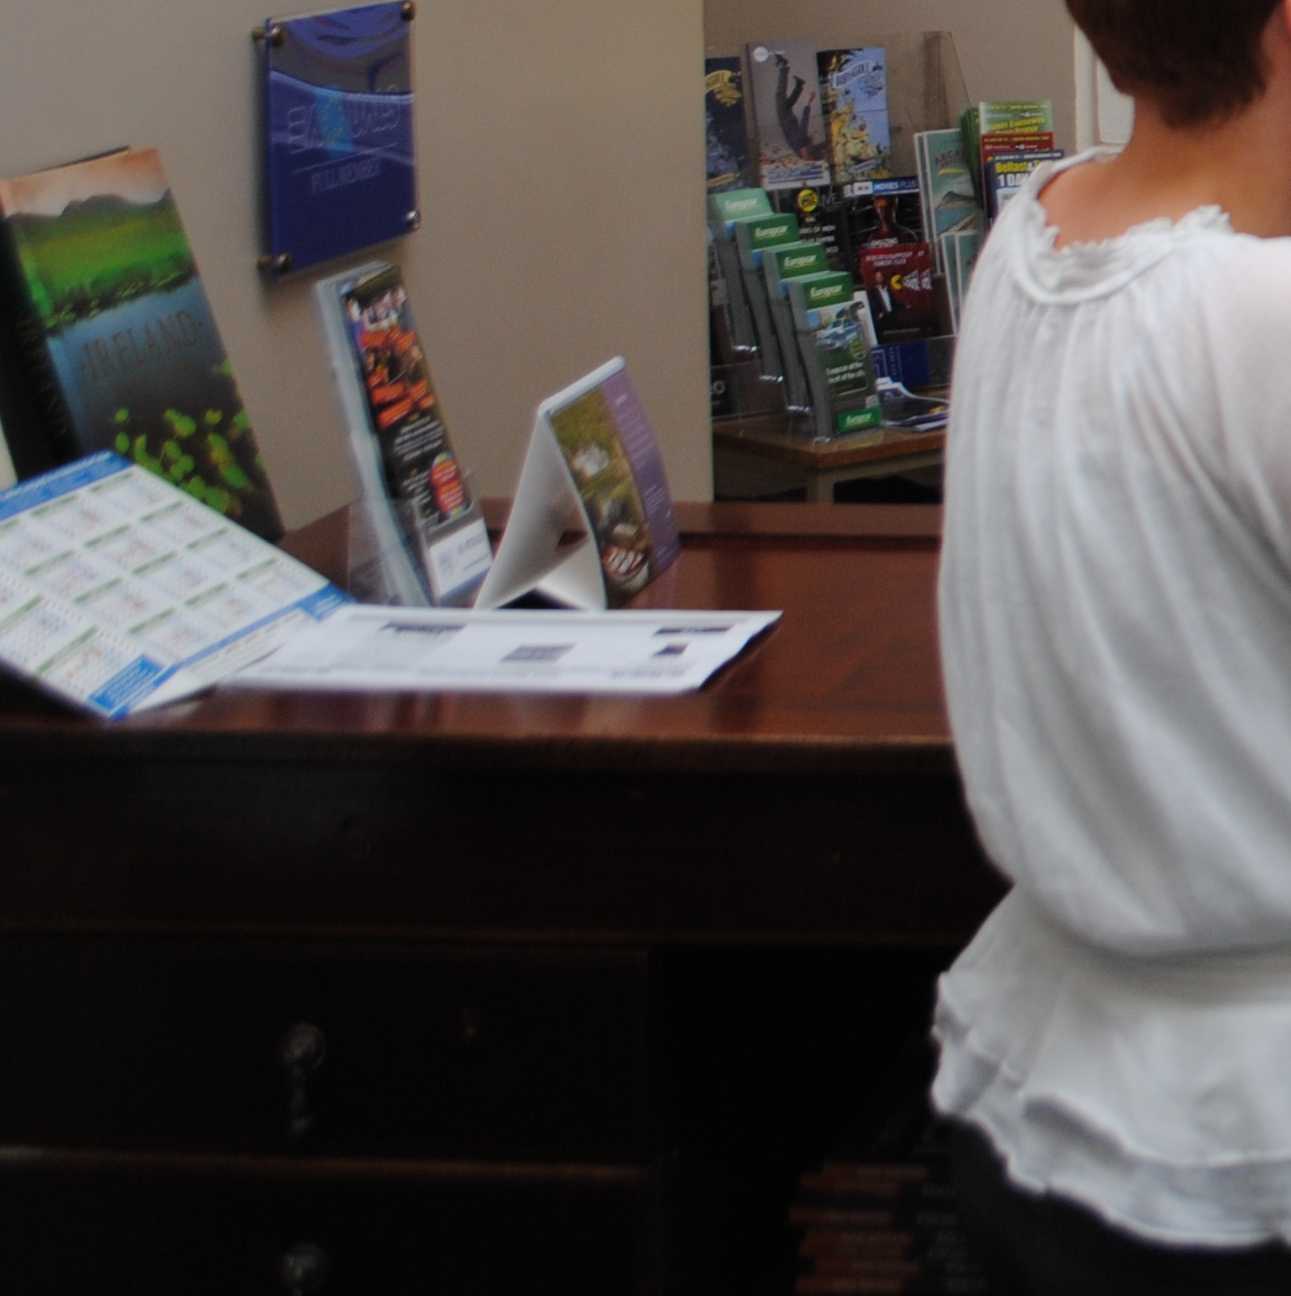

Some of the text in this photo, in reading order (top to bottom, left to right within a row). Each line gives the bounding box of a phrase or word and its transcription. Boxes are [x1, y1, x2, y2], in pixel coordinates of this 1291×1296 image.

[995, 161, 1027, 173] Belfast
[755, 224, 789, 238] Europcar
[783, 253, 818, 267] Europcar
[809, 283, 844, 298] Europcar
[82, 308, 200, 383] IRELAND
